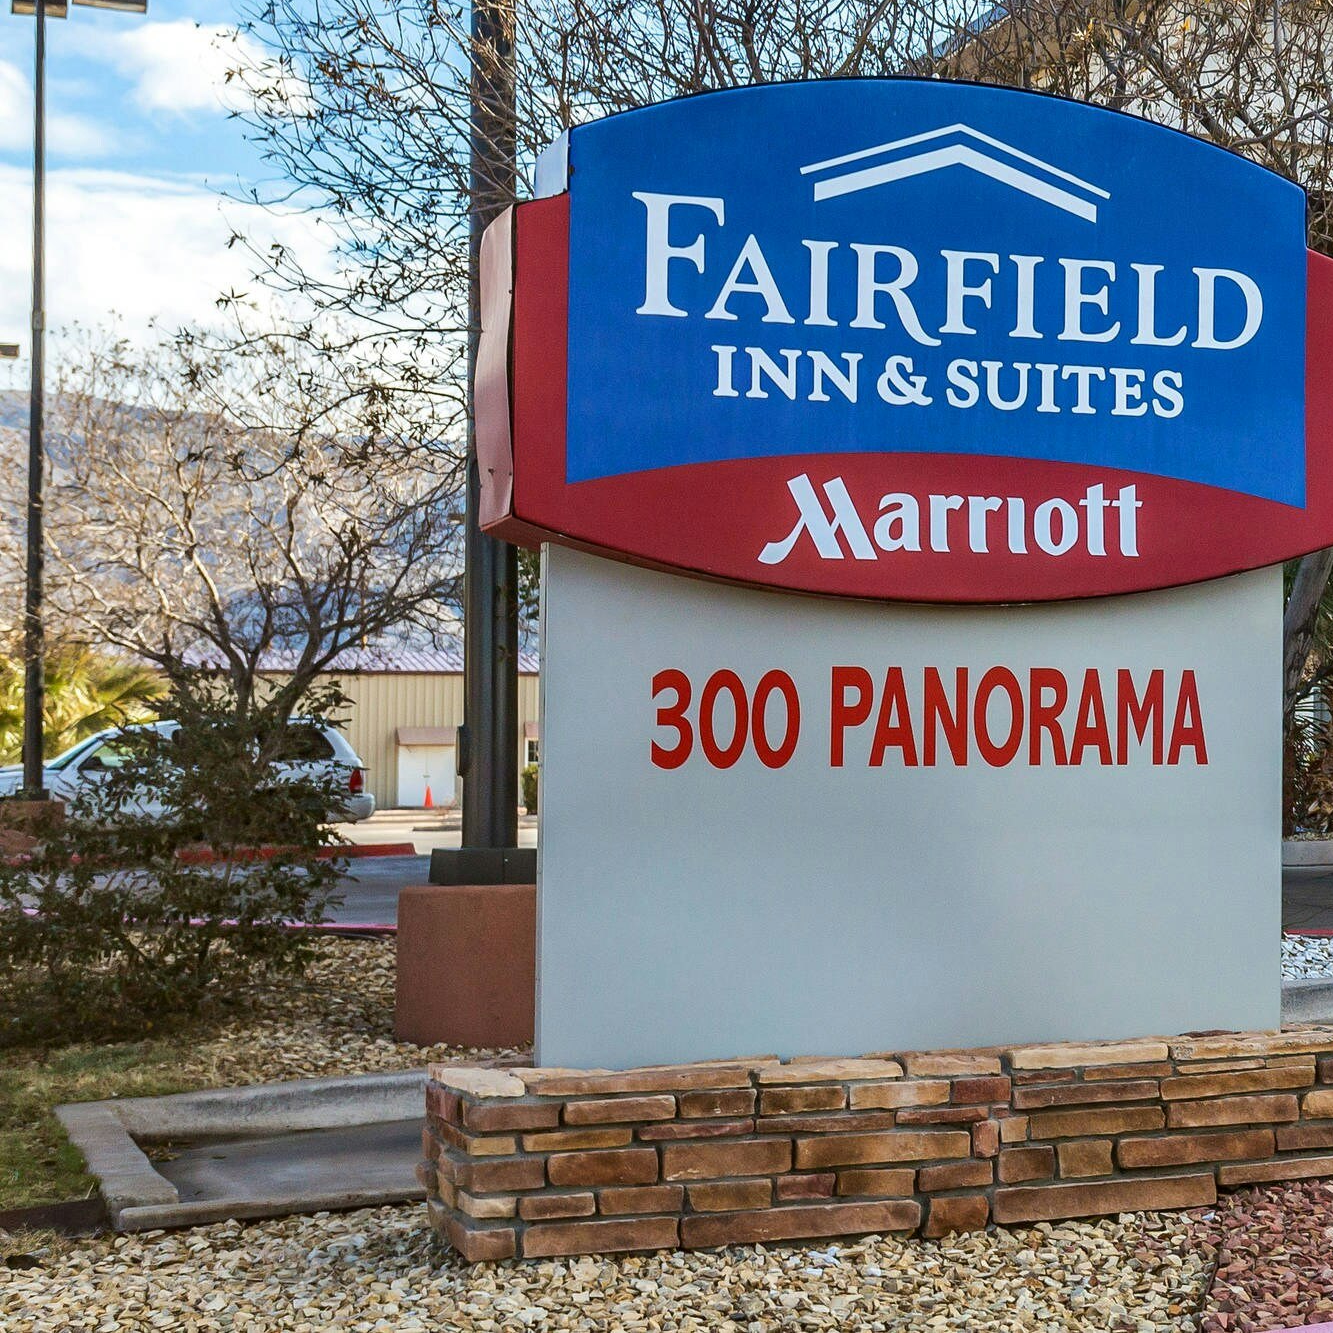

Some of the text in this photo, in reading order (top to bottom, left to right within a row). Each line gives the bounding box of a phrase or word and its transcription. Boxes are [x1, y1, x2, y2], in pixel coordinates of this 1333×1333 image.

[632, 191, 1264, 351] FAIRFIELD
[711, 345, 1184, 420] INN & SUITES
[757, 473, 1143, 565] Marriott
[650, 666, 1210, 771] 300 PANORAMA
